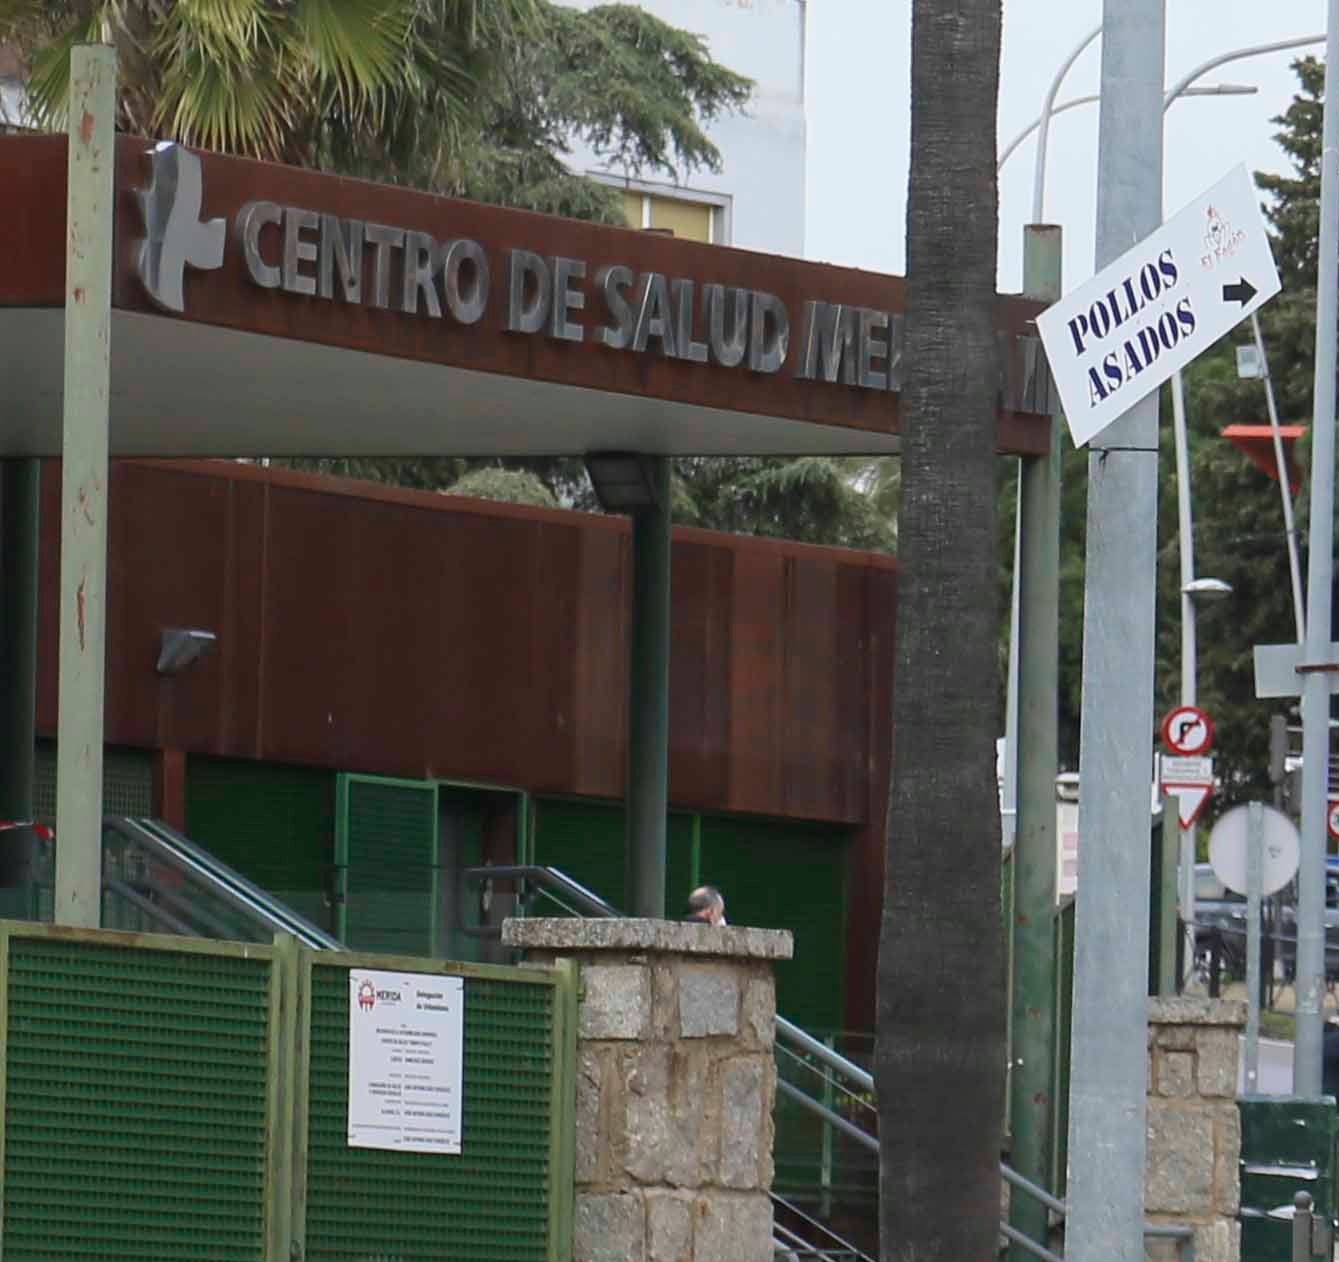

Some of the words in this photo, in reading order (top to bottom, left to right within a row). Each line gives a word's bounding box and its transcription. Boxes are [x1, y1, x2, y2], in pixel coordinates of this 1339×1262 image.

[235, 201, 490, 325] CENTRO
[505, 249, 586, 343] DE
[597, 265, 790, 374] SALUD
[1067, 248, 1178, 358] POLLOS
[1089, 297, 1196, 408] ASADOS
